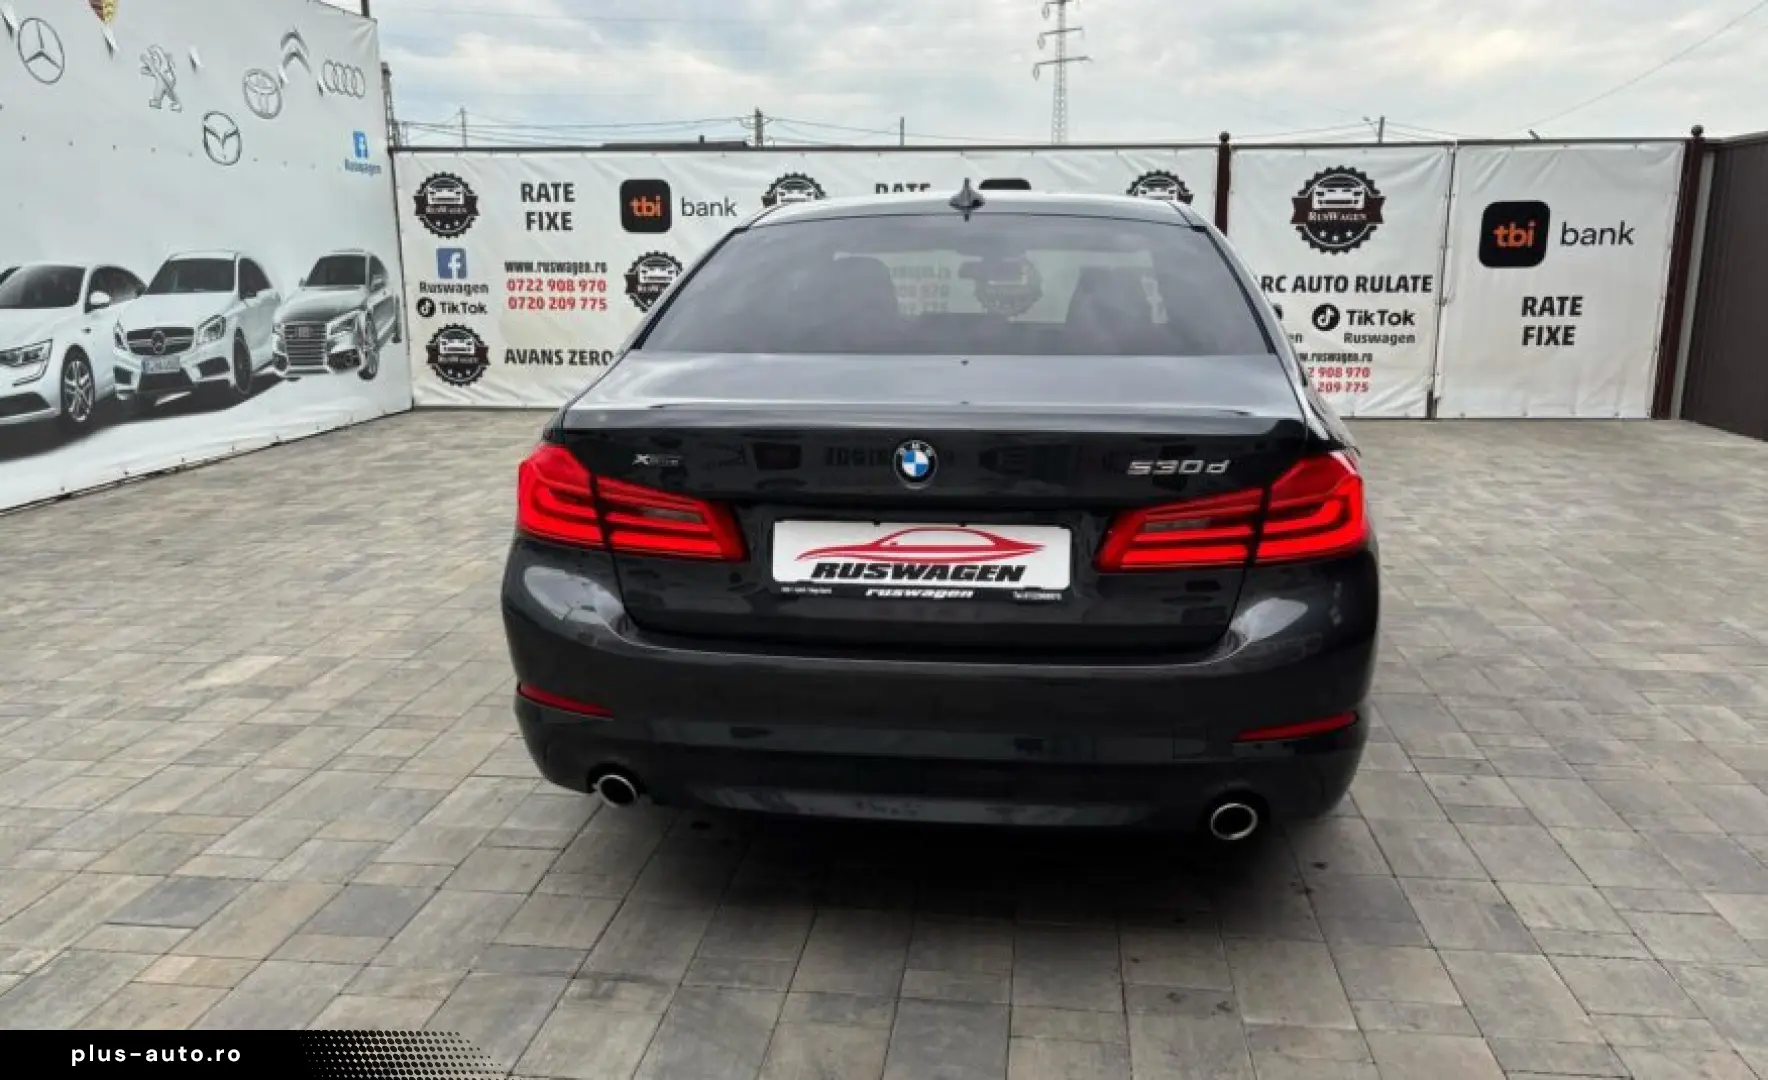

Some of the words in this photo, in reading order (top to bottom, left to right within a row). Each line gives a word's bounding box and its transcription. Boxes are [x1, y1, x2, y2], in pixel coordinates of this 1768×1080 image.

[520, 182, 575, 203] RATE
[630, 195, 662, 217] tbi
[681, 196, 737, 217] bank
[525, 211, 573, 231] FIXE
[1493, 219, 1537, 248] tbi
[1560, 220, 1635, 246] bank
[504, 261, 608, 275] www.ruswagen.ro
[419, 281, 489, 296] Ruswagen
[506, 279, 544, 292] 0722
[548, 279, 575, 292] 908
[578, 279, 607, 293] 970
[1261, 274, 1288, 294] RC
[1292, 274, 1349, 294] AUTO
[1355, 274, 1434, 294] RULATE
[440, 301, 488, 315] TikTok
[507, 296, 545, 310] 0720
[548, 296, 576, 310] 209
[579, 297, 608, 311] 775
[1521, 295, 1584, 318] RATE
[1346, 308, 1416, 326] TikTok
[1343, 332, 1416, 346] Ruswagen
[1521, 324, 1577, 346] FIXE
[504, 348, 564, 366] AVANS
[568, 348, 615, 366] ZERO
[1298, 352, 1373, 364] w.ruswagen.ro
[1126, 459, 1231, 475] 530d
[810, 562, 1027, 582] RUSWAGEN
[866, 587, 975, 600] ruswagen
